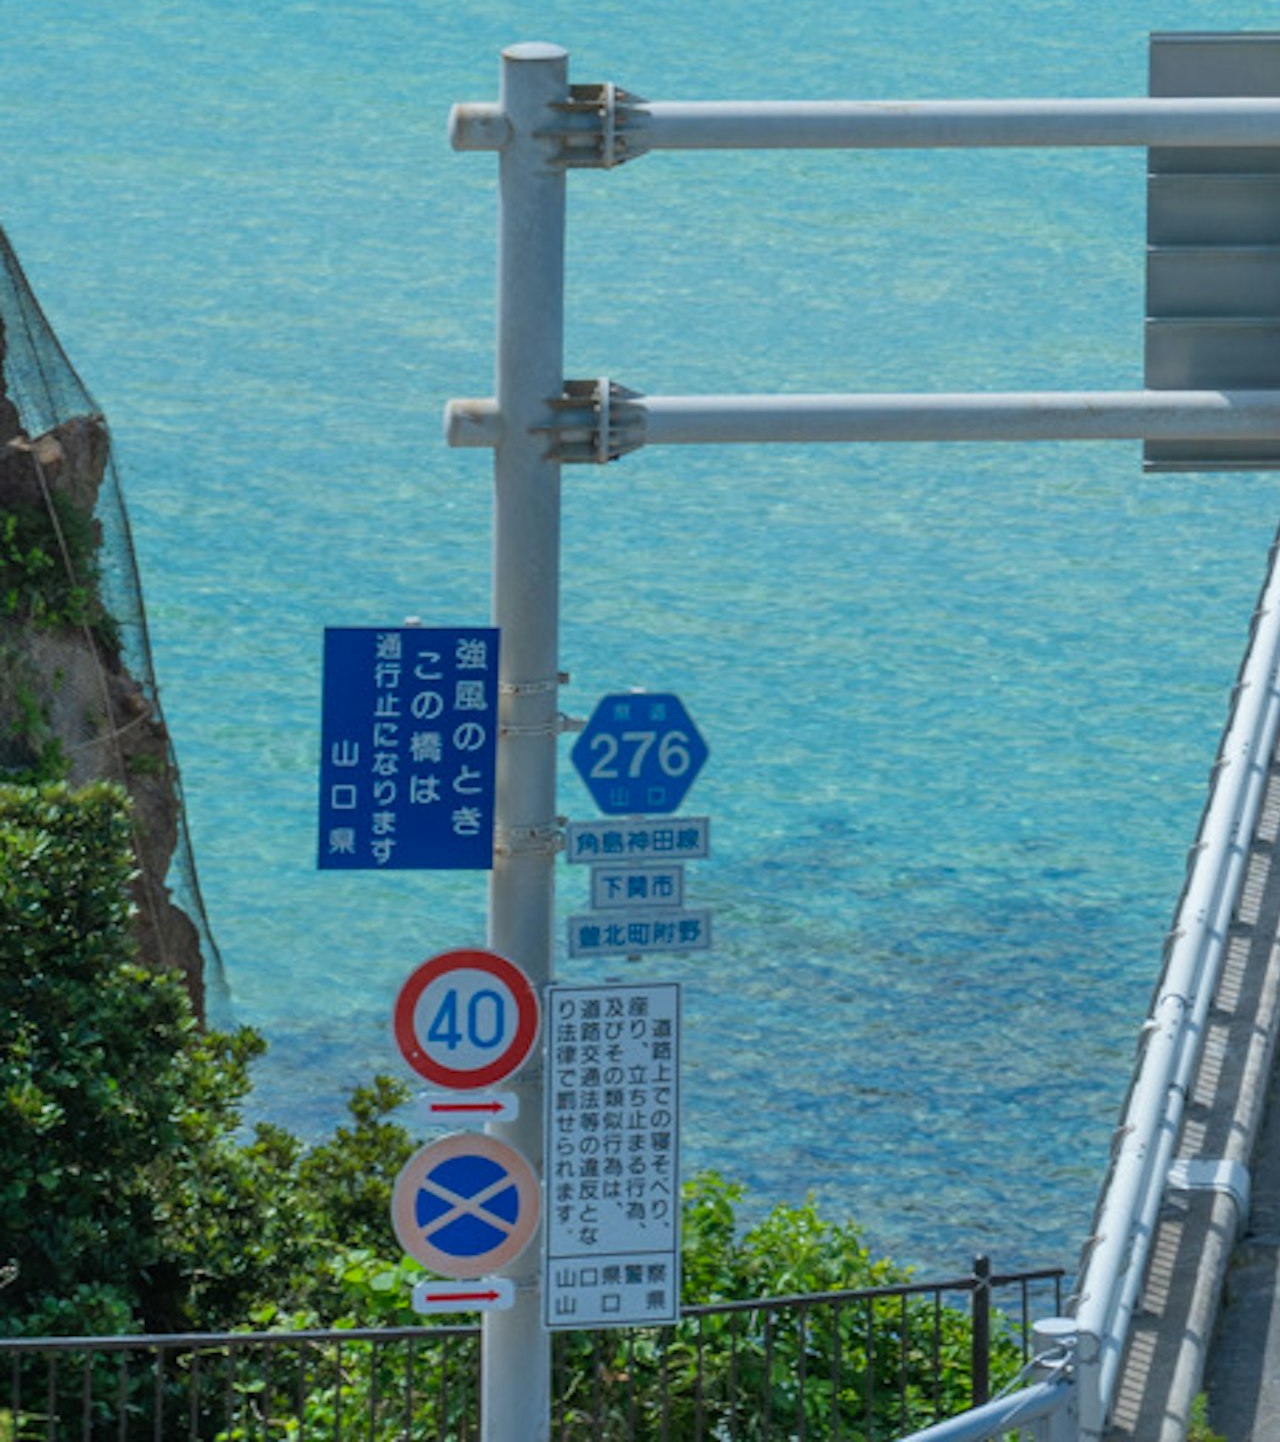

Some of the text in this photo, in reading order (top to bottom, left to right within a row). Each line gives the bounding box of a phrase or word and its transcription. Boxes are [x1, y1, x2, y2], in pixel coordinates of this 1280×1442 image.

[371, 632, 401, 864] 通行止になります
[410, 651, 444, 804] この橋は
[453, 638, 488, 835] 強風のとき
[590, 731, 690, 778] 276
[329, 739, 359, 854] 山口県
[610, 787, 666, 807] 山口
[577, 828, 699, 854] 角島神田線
[602, 875, 673, 898] 下関市
[427, 989, 504, 1049] 40
[557, 1264, 665, 1288] 山口県警察
[556, 1290, 665, 1315] 山口県
